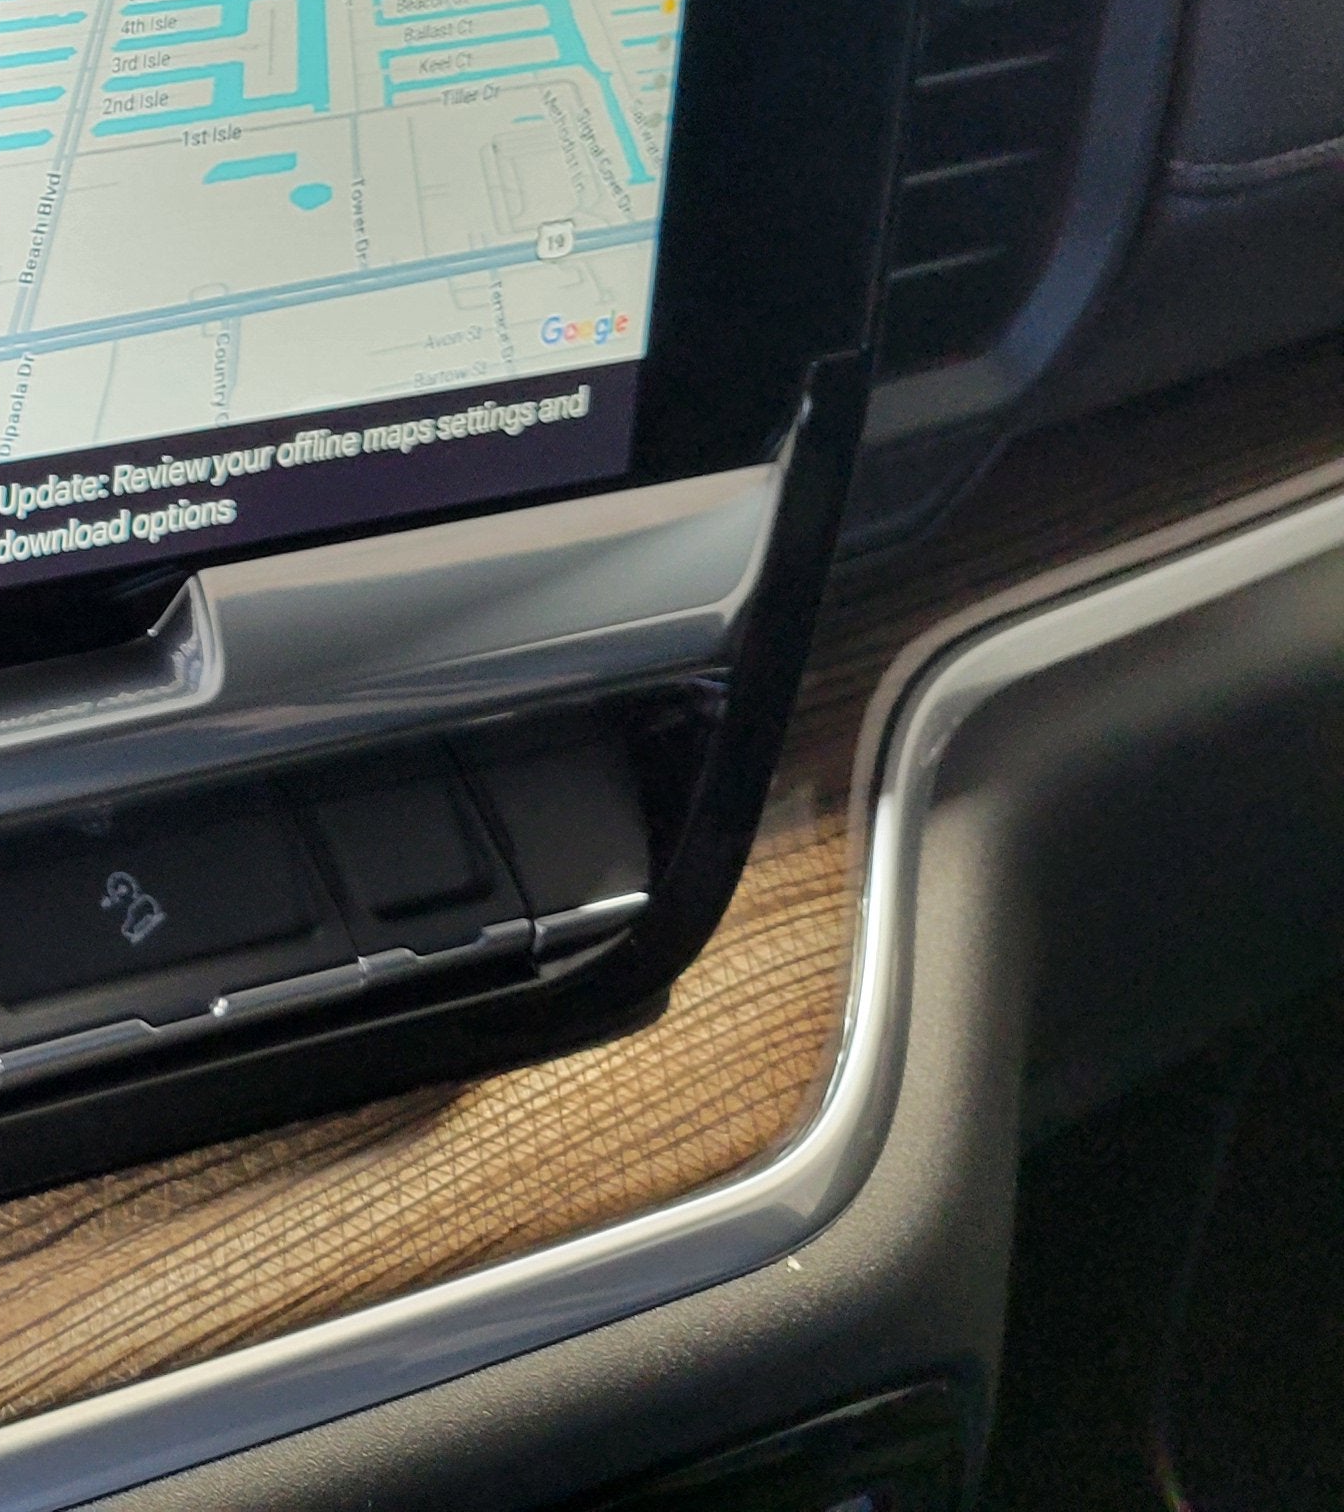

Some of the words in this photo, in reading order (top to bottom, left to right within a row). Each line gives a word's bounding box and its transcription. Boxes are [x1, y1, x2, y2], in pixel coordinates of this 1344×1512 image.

[121, 19, 145, 34] 4th
[150, 15, 177, 30] Isle
[112, 56, 138, 74] 3rd
[143, 51, 170, 68] Isle
[102, 95, 135, 115] 2nd
[140, 91, 169, 110] Isle
[182, 129, 208, 148] 1st
[213, 123, 242, 143] Isle
[352, 178, 366, 236] Tower
[18, 222, 49, 285] Beach
[37, 172, 62, 217] Blvd
[355, 238, 369, 266] Dr
[540, 310, 630, 346] Google
[17, 352, 35, 377] Dr
[210, 333, 230, 407] Country
[113, 454, 209, 496] Review
[210, 445, 275, 486] your
[276, 427, 361, 469] offline
[362, 417, 436, 456] maps
[436, 399, 538, 441] settings
[538, 385, 591, 424] and
[132, 497, 238, 545] options
